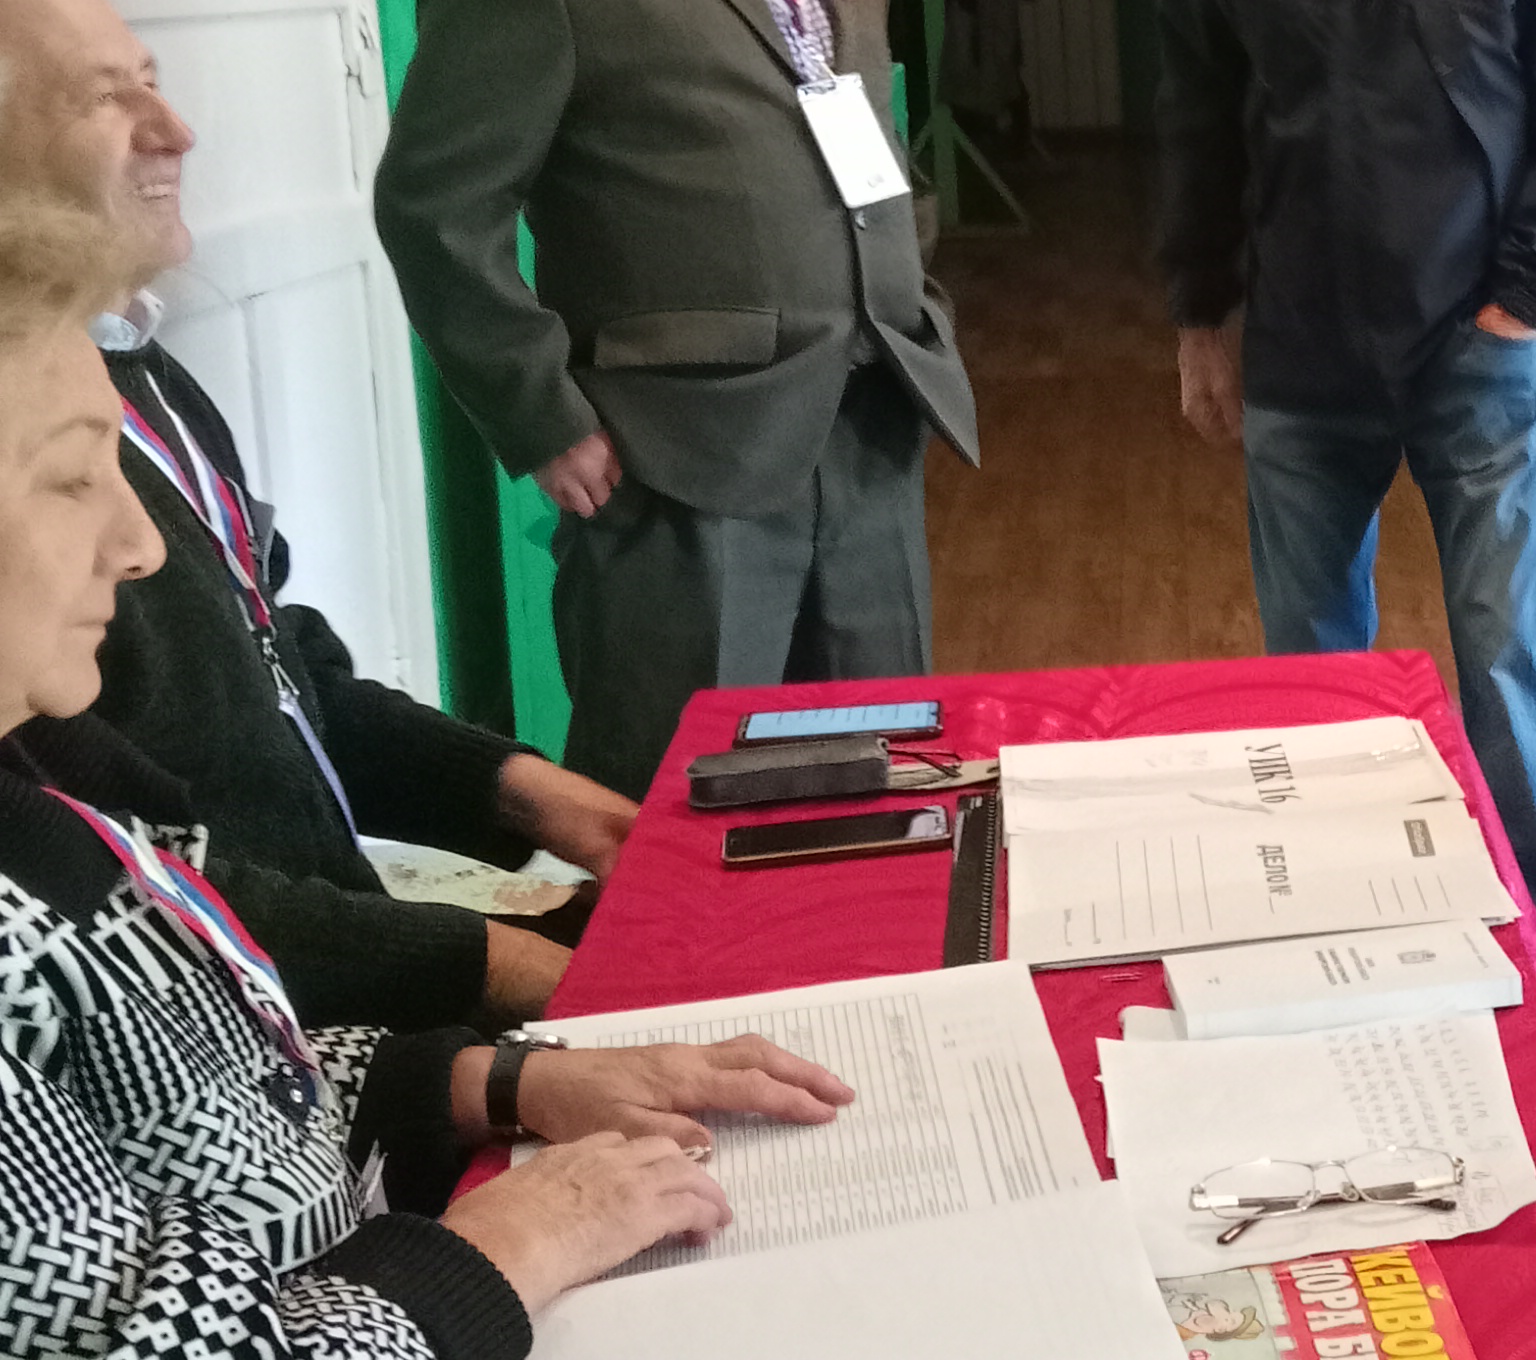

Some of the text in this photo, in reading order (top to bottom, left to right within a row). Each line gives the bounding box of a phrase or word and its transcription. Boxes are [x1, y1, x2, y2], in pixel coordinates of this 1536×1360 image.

[1245, 743, 1302, 804] УИК 16
[1256, 844, 1289, 883] ДЕЛО
[1289, 1258, 1366, 1332] ПОРА
